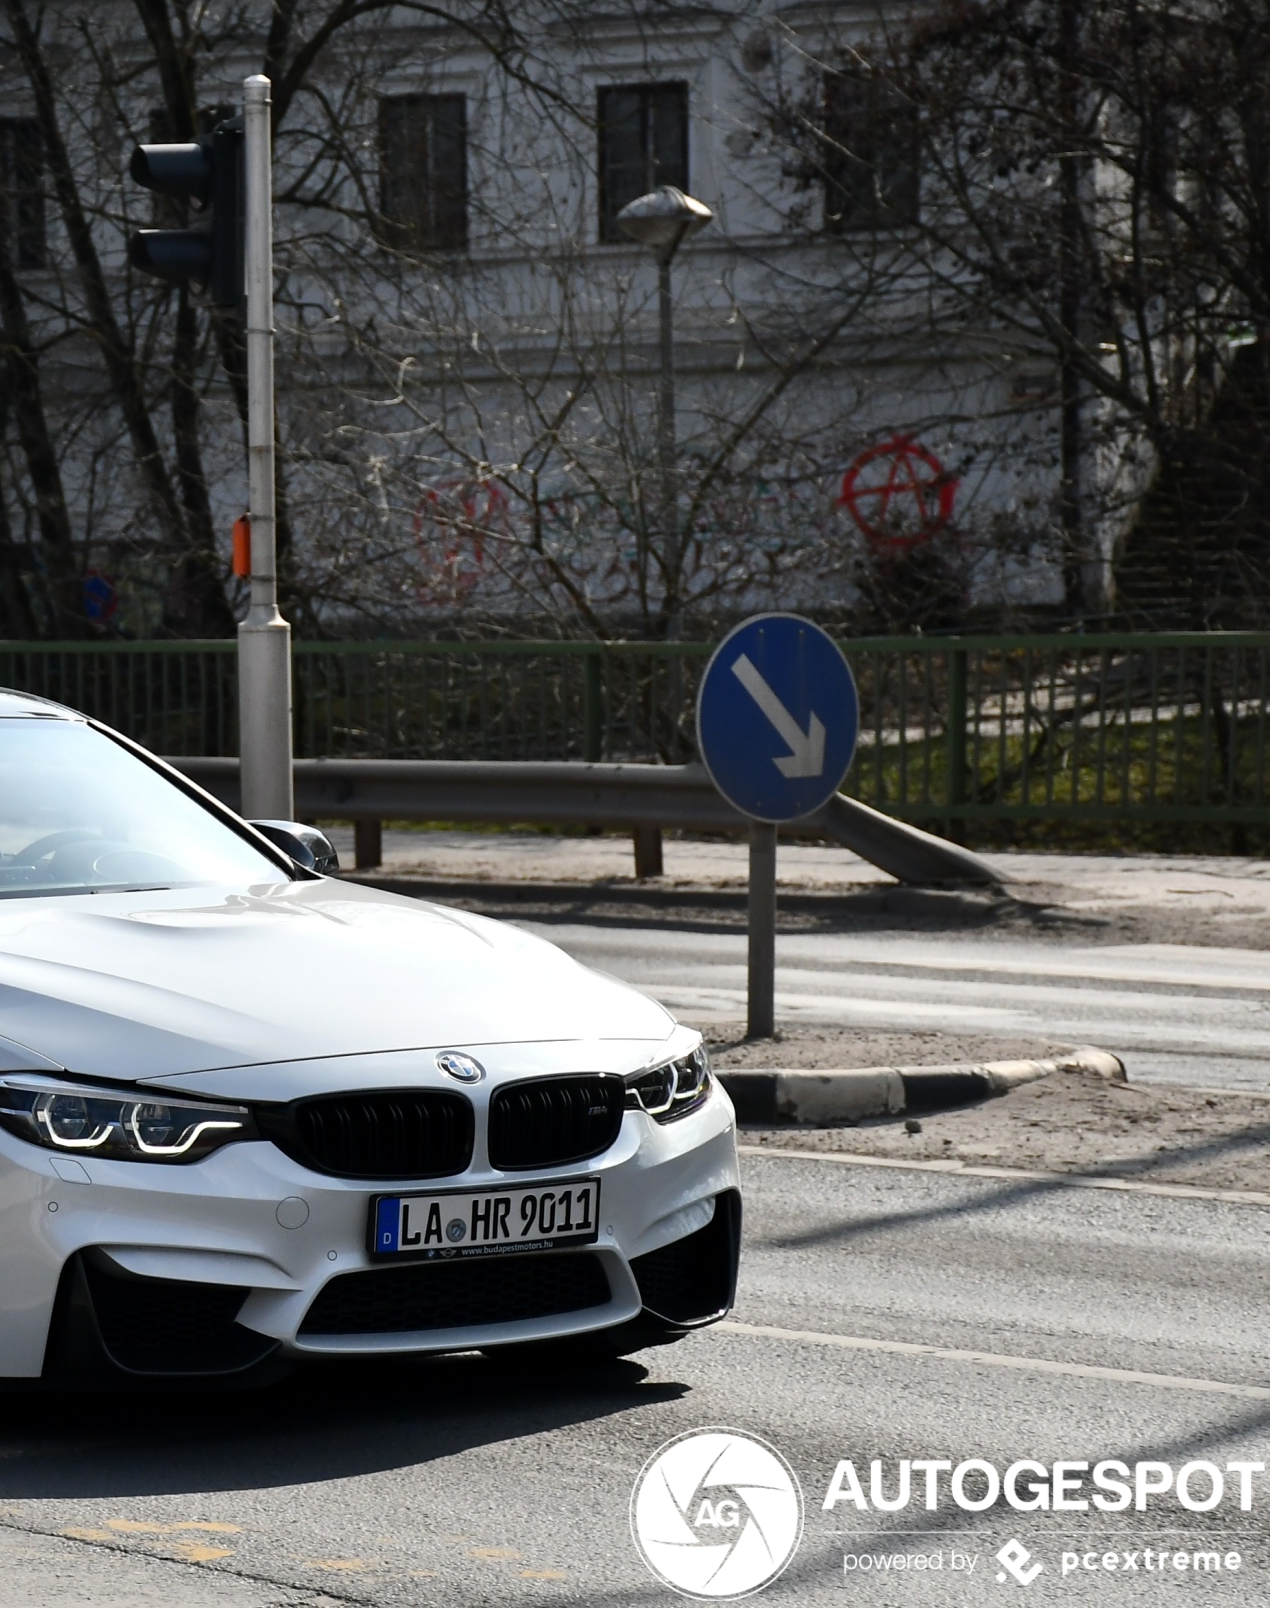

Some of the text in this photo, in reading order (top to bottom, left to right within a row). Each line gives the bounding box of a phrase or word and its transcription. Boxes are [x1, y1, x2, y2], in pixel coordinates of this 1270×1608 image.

[401, 1188, 592, 1245] LA HR 9011
[383, 1232, 391, 1245] D
[461, 1240, 553, 1256] www.budapestmotors.hu
